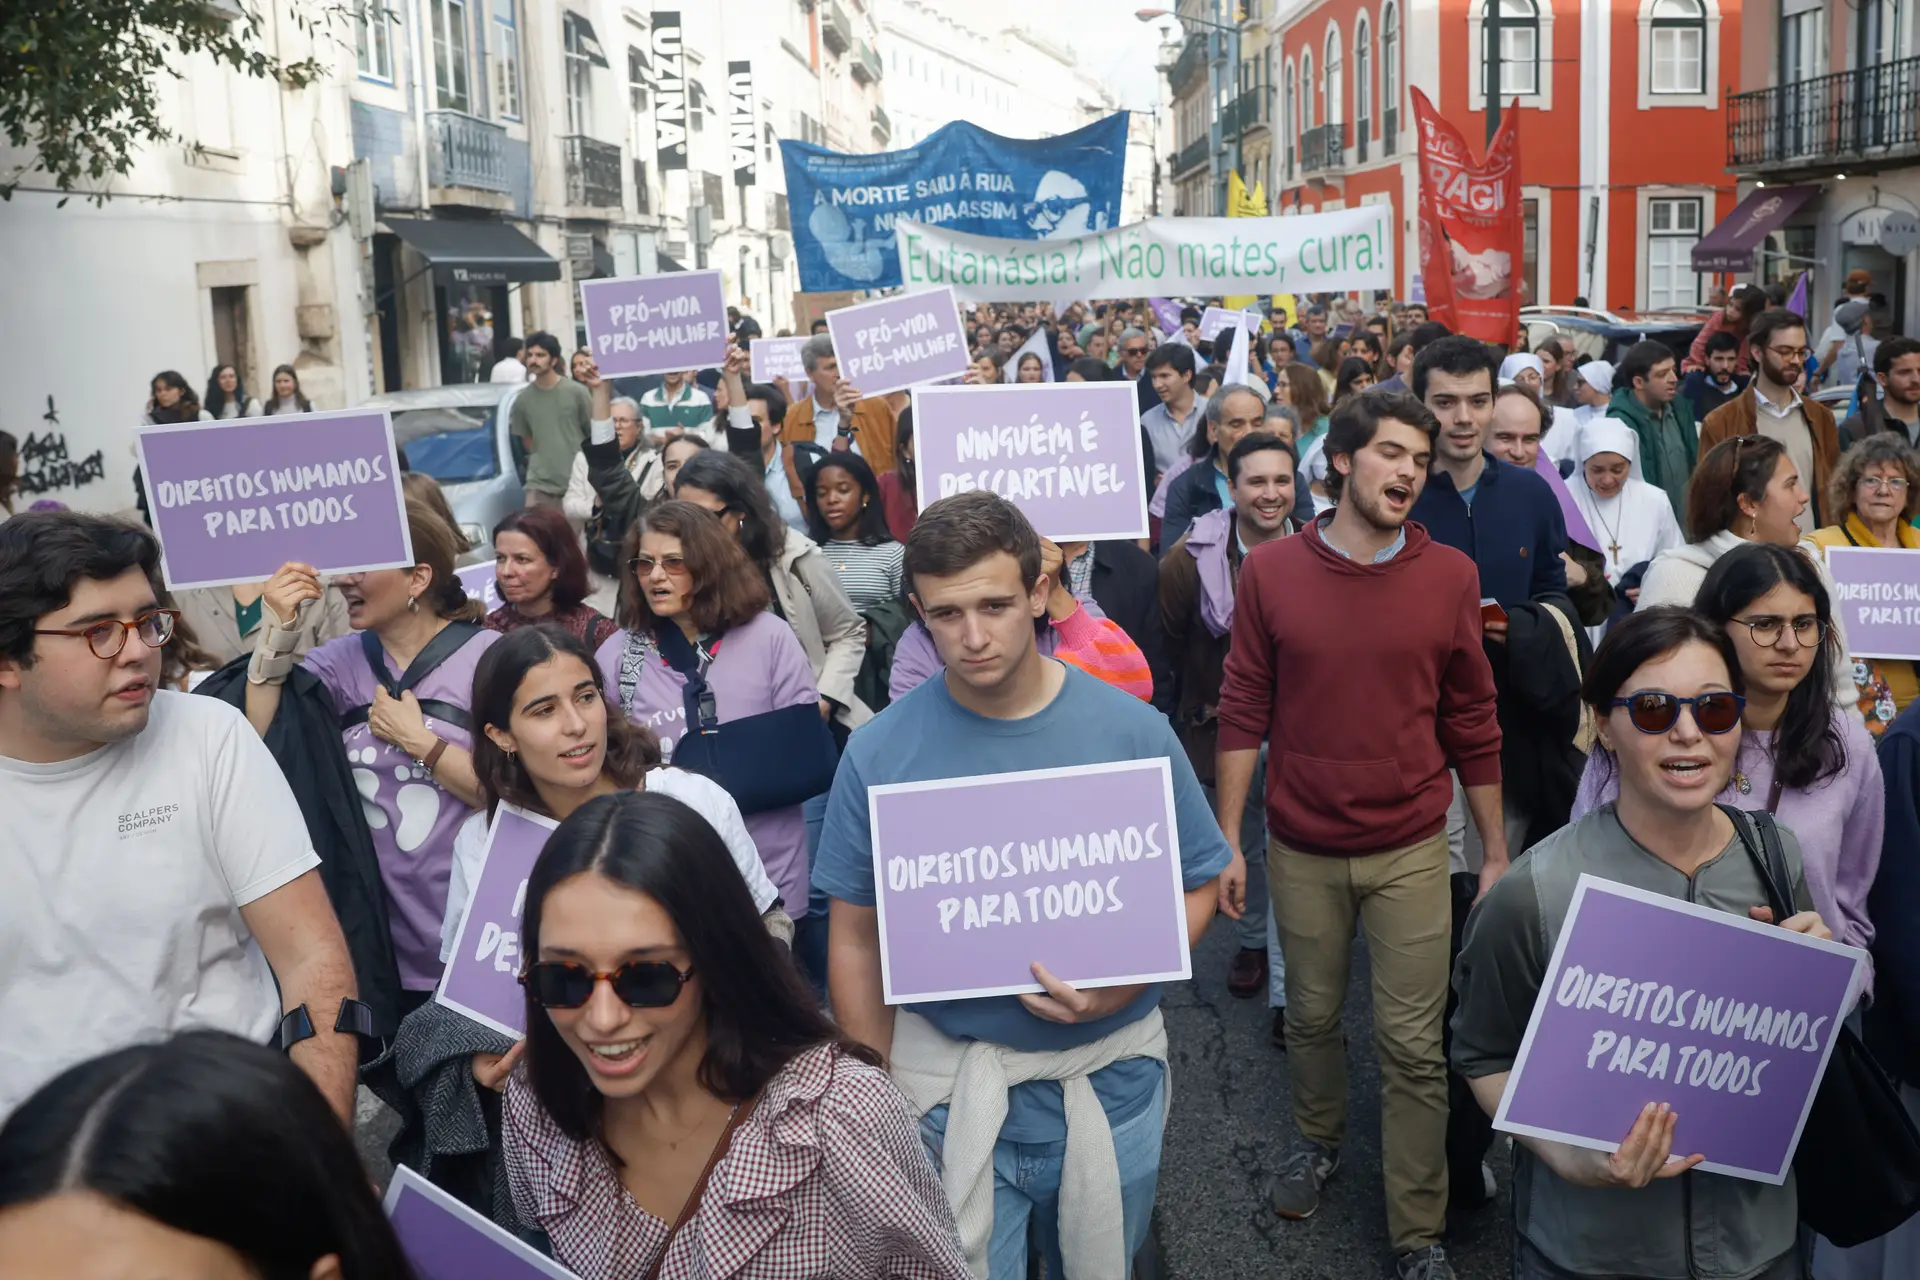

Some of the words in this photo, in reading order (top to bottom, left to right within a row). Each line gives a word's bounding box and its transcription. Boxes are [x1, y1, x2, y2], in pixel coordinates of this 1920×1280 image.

[652, 26, 686, 150] UZINA
[728, 72, 756, 171] UZINA
[813, 189, 828, 206] A
[832, 184, 910, 206] MORTE
[915, 174, 956, 199] SAIU
[959, 170, 972, 191] À
[976, 172, 1015, 193] RUA
[874, 206, 922, 232] NUM
[925, 204, 956, 224] DIA
[957, 201, 1018, 222] ASSIM
[906, 234, 1082, 286] Eutanásia?
[1099, 230, 1166, 279] Não
[1179, 234, 1287, 282] mates,
[1299, 218, 1385, 274] cura!
[609, 295, 702, 327] PRÓ-VIDA
[855, 312, 938, 349] PRÓ-VIDA
[598, 320, 721, 356] PRÓ-MULHER
[847, 332, 959, 378] PRÓ-MULHER
[956, 413, 1074, 463] NINGUÉM
[1078, 410, 1099, 452] É
[157, 469, 269, 508] DIREITOS
[269, 455, 387, 495] HUMANOS
[938, 454, 1126, 501] DESCARTÁVEL
[203, 506, 275, 538] PARA
[275, 494, 358, 530] TODOS
[1857, 606, 1902, 625] PARA
[118, 803, 179, 824] SCALPERS
[118, 814, 172, 833] COMPANY
[888, 842, 1018, 892] DIREITOS
[1020, 821, 1164, 875] HUMANOS
[936, 891, 1022, 934] PARA
[1022, 875, 1124, 923] TODOS
[1556, 964, 1697, 1028] DIREITOS
[1690, 993, 1829, 1053] HUMANOS
[1586, 1029, 1669, 1081] PARA
[1674, 1045, 1772, 1097] TODOS
